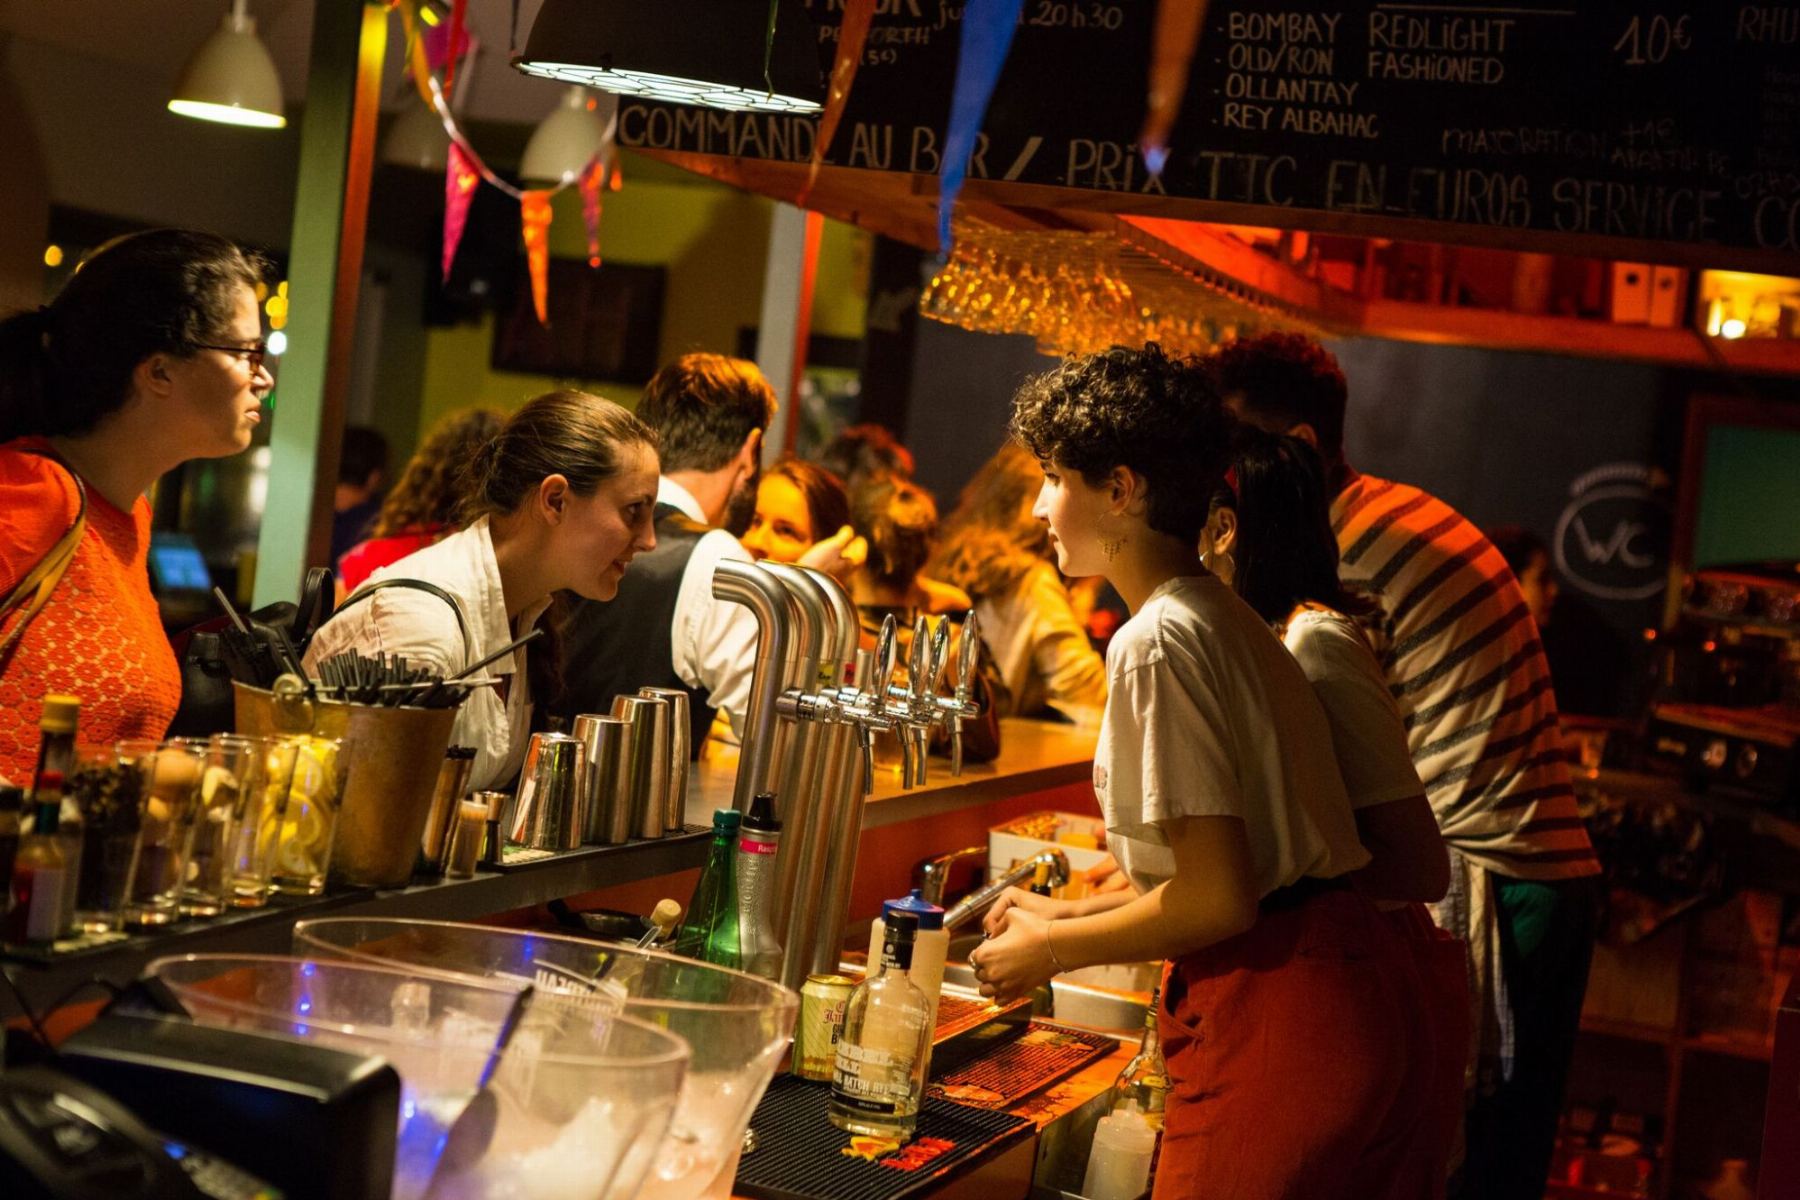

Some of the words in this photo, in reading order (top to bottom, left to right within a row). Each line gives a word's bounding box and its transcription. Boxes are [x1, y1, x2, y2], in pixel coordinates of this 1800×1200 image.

[1229, 11, 1344, 44] BOMBAY
[1368, 12, 1517, 52] REDLIGHT
[1228, 42, 1335, 76] OLD/RON
[1367, 51, 1504, 85] FASHIONED
[1225, 73, 1360, 106] OLLANTAY
[1223, 102, 1274, 131] REY
[1281, 107, 1380, 139] ALBAHAC
[849, 121, 893, 169] AU
[909, 125, 990, 179] BR
[1199, 151, 1297, 207] TTC
[1553, 176, 1722, 242] SERVICE
